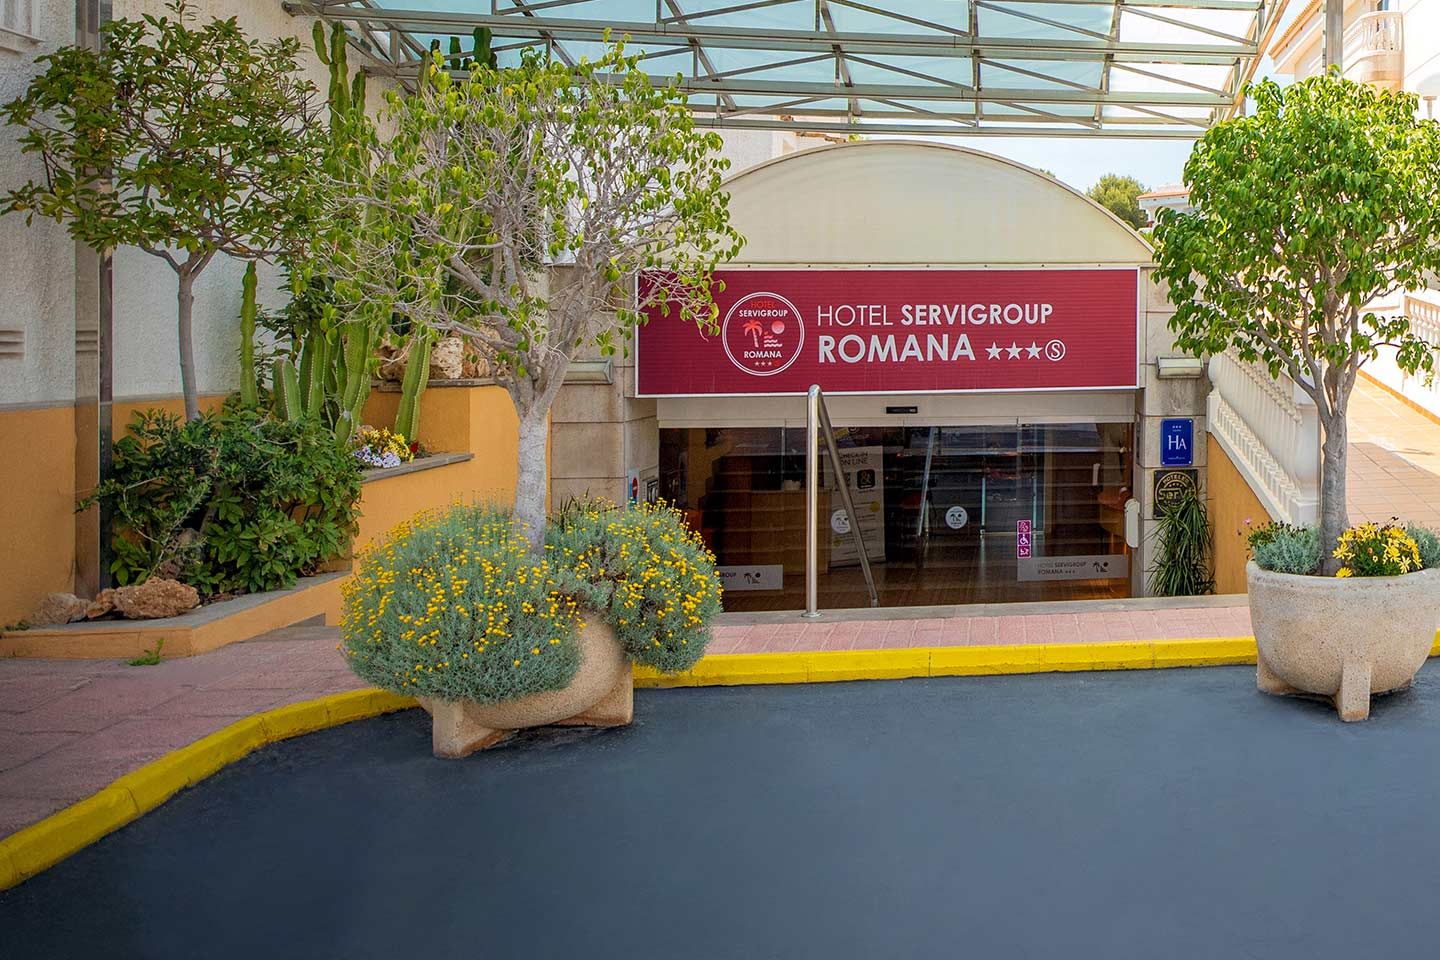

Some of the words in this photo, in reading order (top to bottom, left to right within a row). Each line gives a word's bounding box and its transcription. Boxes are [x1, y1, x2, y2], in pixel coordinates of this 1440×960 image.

[751, 300, 776, 309] HOTEL
[739, 309, 788, 318] SERVIGROUP
[817, 305, 894, 327] HOTEL
[900, 303, 1053, 326] SERVIGROUP
[818, 333, 976, 364] ROMANA
[743, 350, 783, 359] ROMANA
